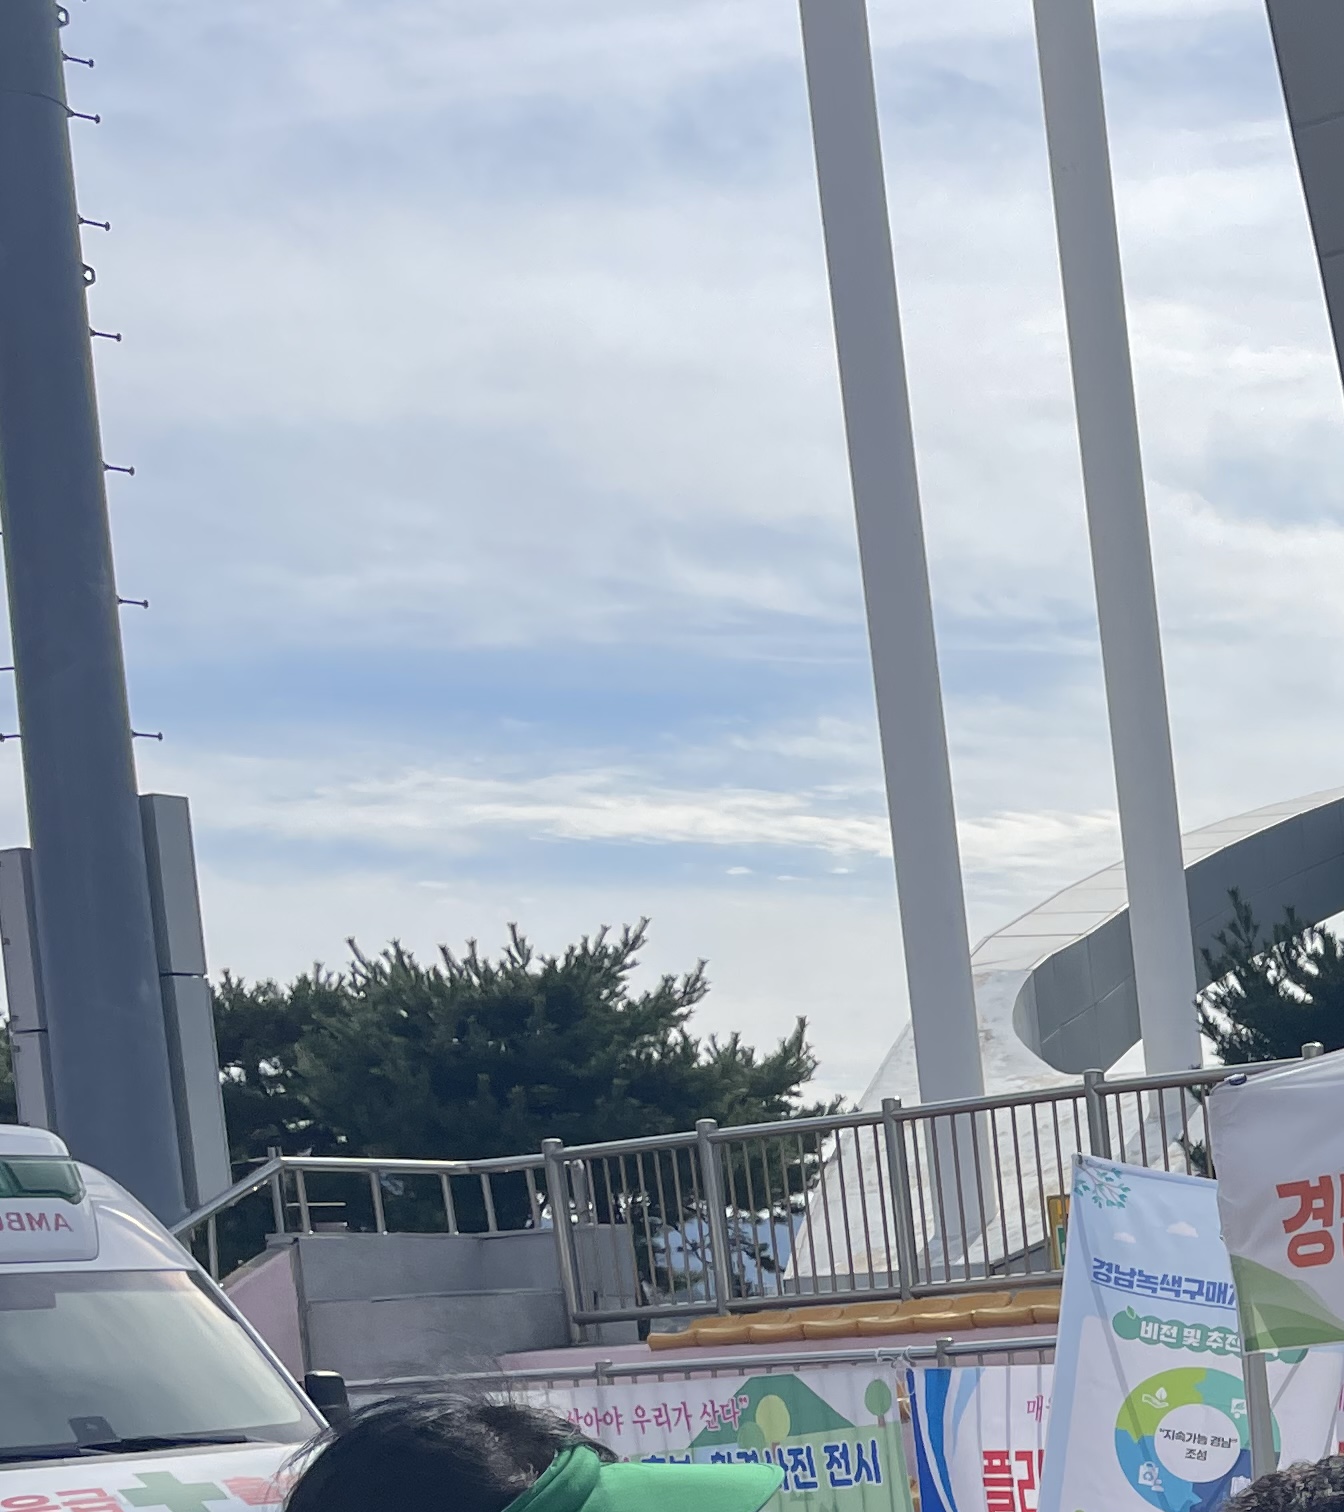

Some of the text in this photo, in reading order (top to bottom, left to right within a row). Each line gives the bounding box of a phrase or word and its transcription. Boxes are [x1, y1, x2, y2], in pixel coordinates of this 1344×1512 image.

[1140, 1321, 1178, 1343] 비전
[1182, 1328, 1201, 1347] 및
[632, 1402, 692, 1434] 우리가
[823, 1439, 882, 1488] 전시
